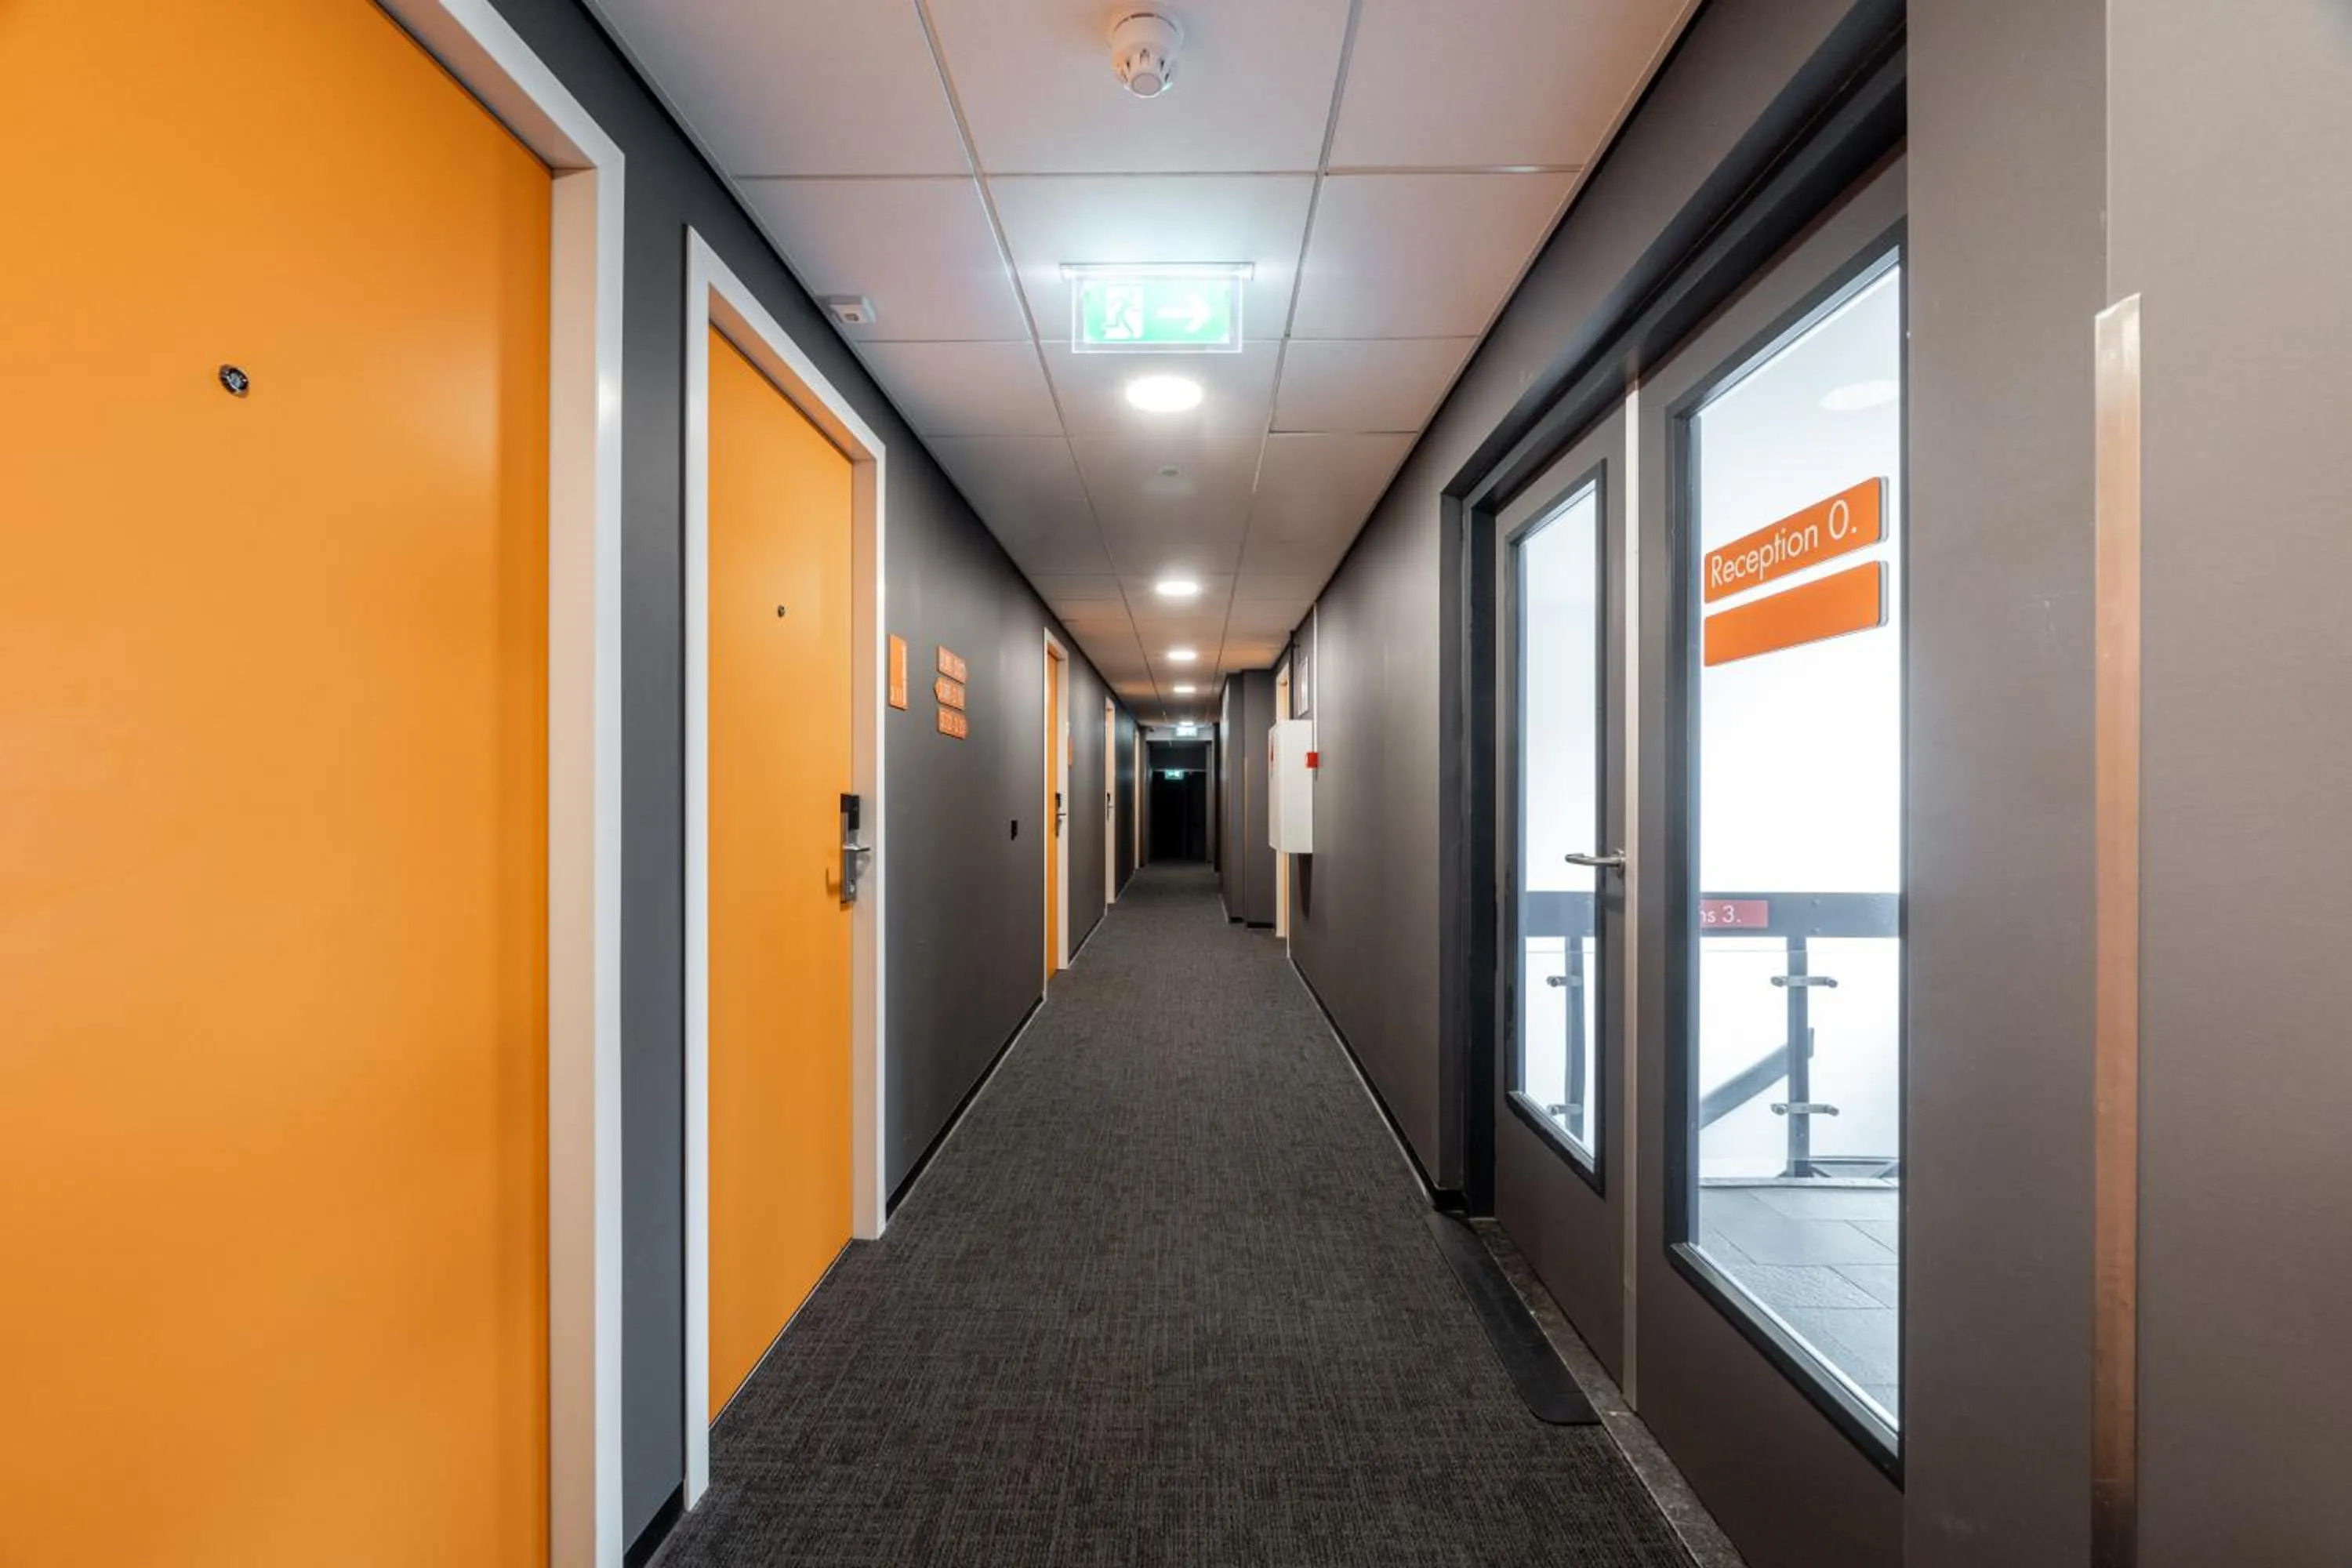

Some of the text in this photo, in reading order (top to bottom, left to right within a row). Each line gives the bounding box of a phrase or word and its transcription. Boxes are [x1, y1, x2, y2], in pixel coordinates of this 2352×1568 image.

[1711, 499, 1857, 587] Reception 0.
[1722, 904, 1741, 924] 3.
